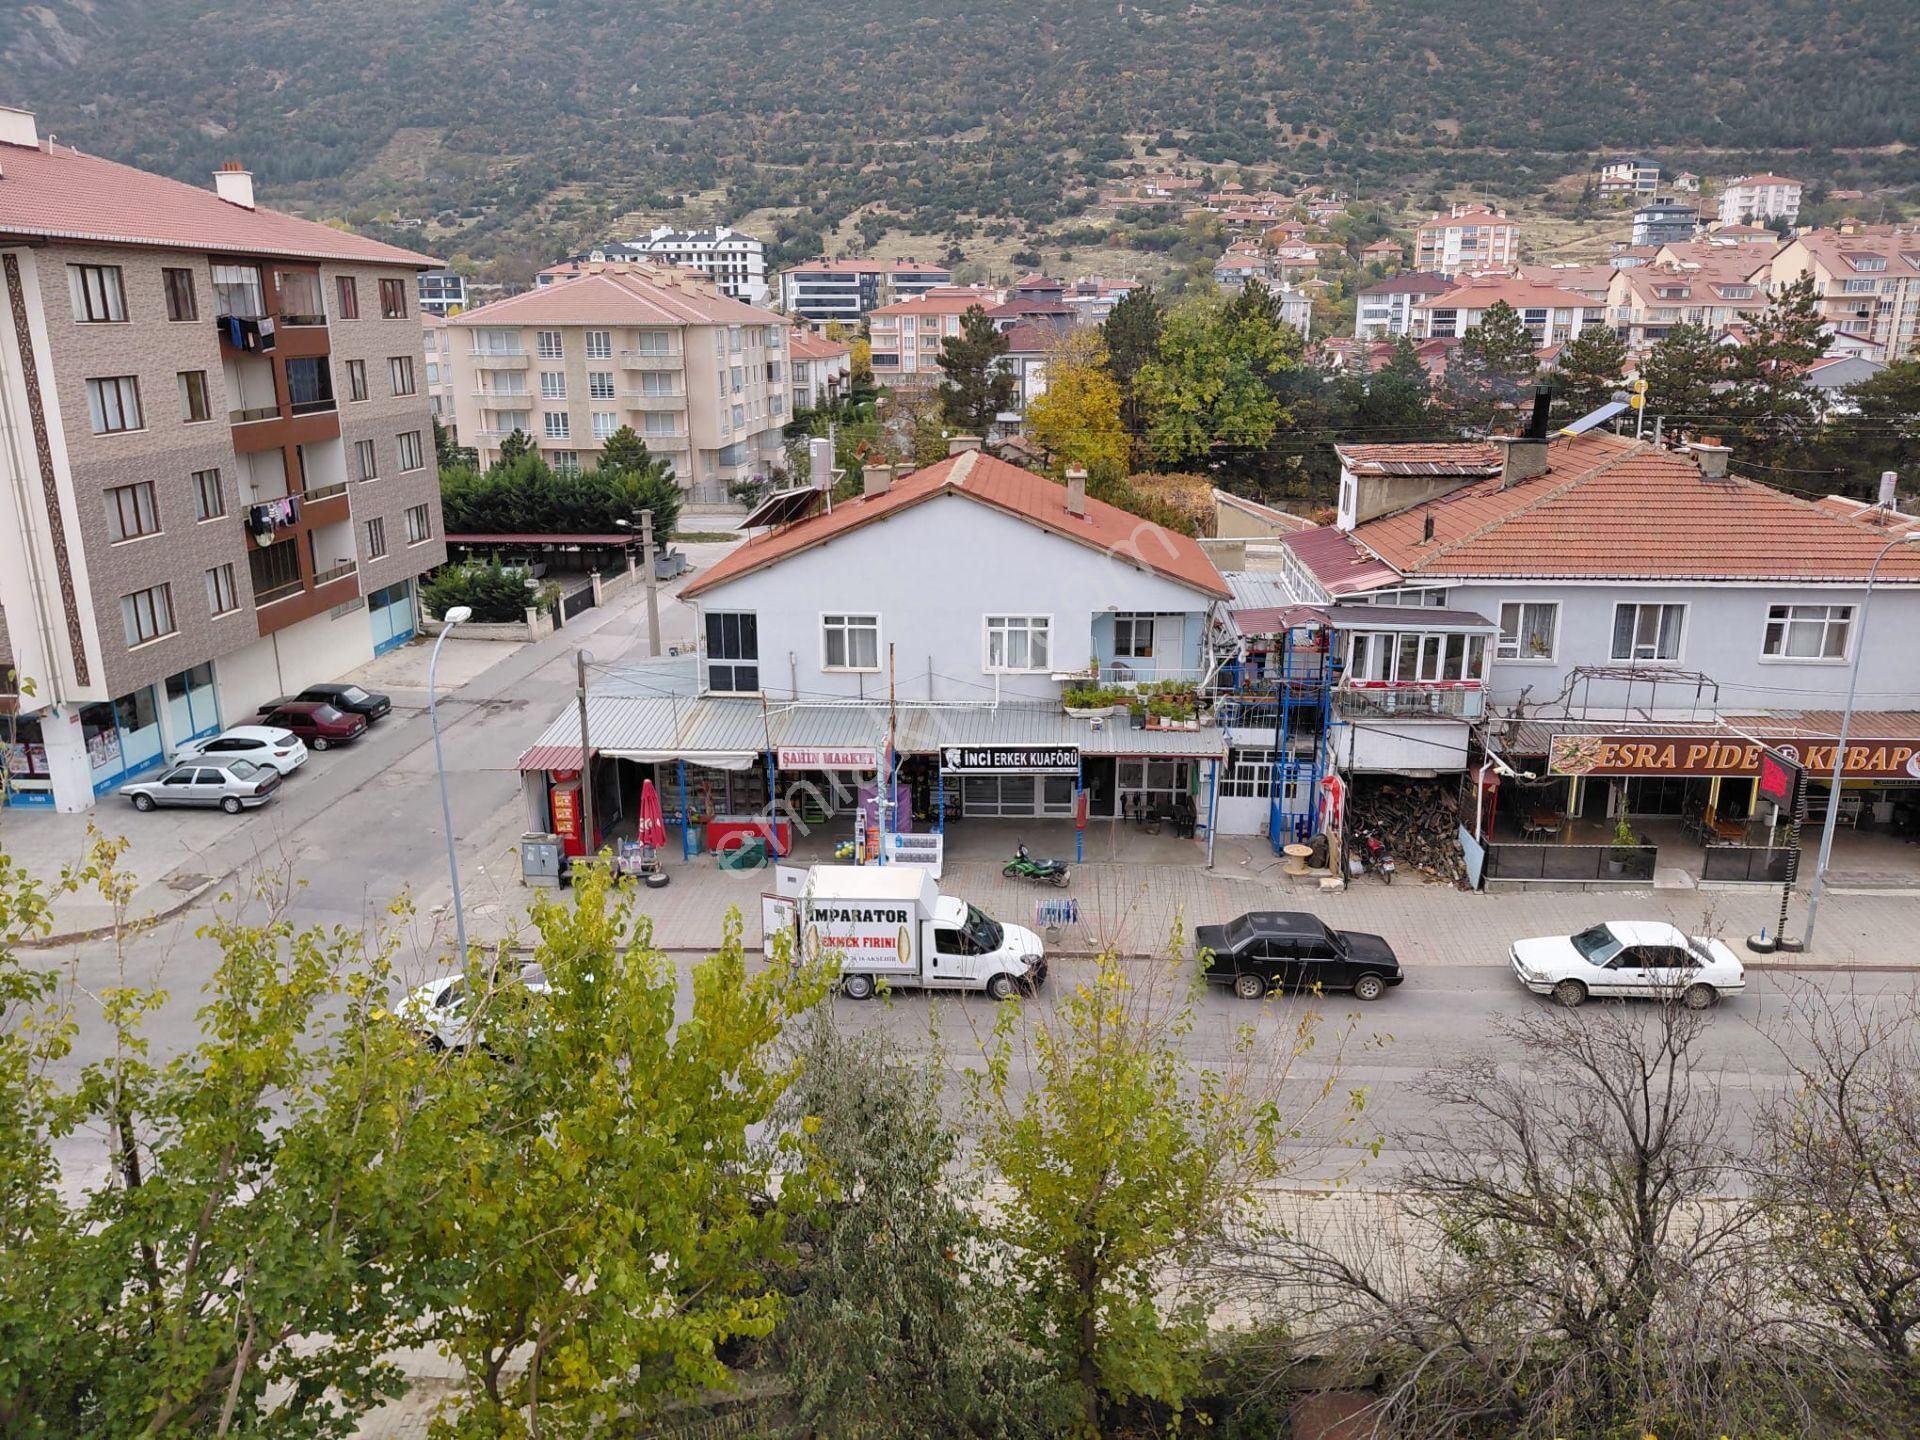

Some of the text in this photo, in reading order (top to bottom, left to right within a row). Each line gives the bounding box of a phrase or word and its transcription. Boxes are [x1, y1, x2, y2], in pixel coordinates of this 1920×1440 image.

[822, 752, 875, 764] MARKET
[965, 749, 1077, 766] İNCİ ERKEK KUAFÖRÜ
[1600, 744, 1676, 768] ESRA
[1684, 740, 1763, 769] PİDE
[1804, 746, 1912, 770] KEBAP
[822, 937, 896, 948] EKMEK FIRINI
